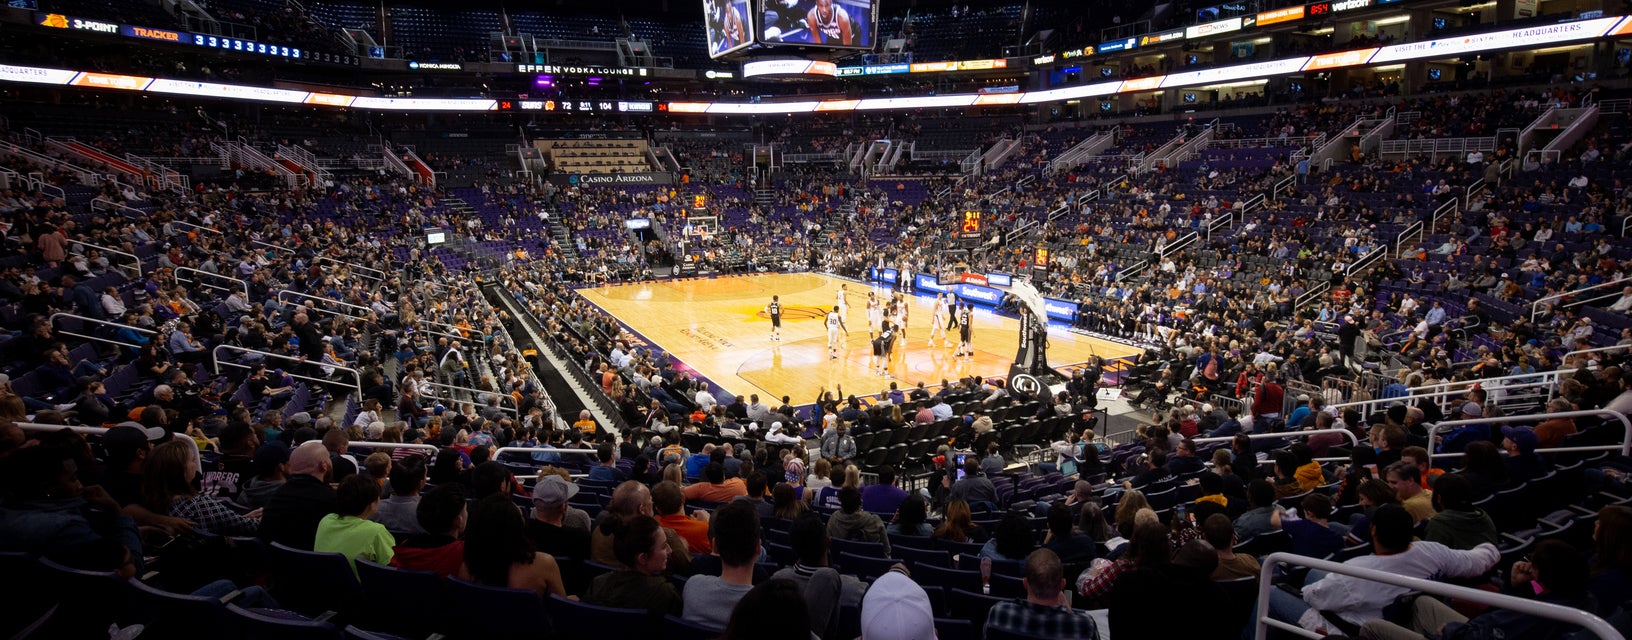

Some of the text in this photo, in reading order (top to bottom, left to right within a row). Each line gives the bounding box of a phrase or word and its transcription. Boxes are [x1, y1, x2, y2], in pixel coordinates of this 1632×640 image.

[1310, 3, 1329, 15] 8:54
[1332, 0, 1369, 12] verizon
[74, 19, 179, 41] 3-POINT TRACKER
[1394, 44, 1412, 53] VISIT
[1512, 23, 1582, 38] HEADQUARTERS
[195, 35, 204, 46] 3
[208, 37, 217, 47] 3
[222, 38, 230, 49] 3
[234, 40, 242, 50] 3
[246, 42, 255, 52] 3
[258, 44, 266, 54] 3
[270, 45, 278, 55] 3
[281, 47, 289, 57] 3
[292, 48, 300, 58] 3
[1034, 54, 1055, 65] verizon
[518, 64, 561, 74] EFFEN
[563, 66, 595, 74] VODKA
[502, 101, 511, 109] 24
[521, 101, 543, 109] SUNS
[561, 102, 572, 110] 72
[599, 102, 612, 110] 104
[580, 174, 654, 184] CASINO ARIZONA
[963, 219, 979, 232] 24
[962, 286, 993, 301] Southwest
